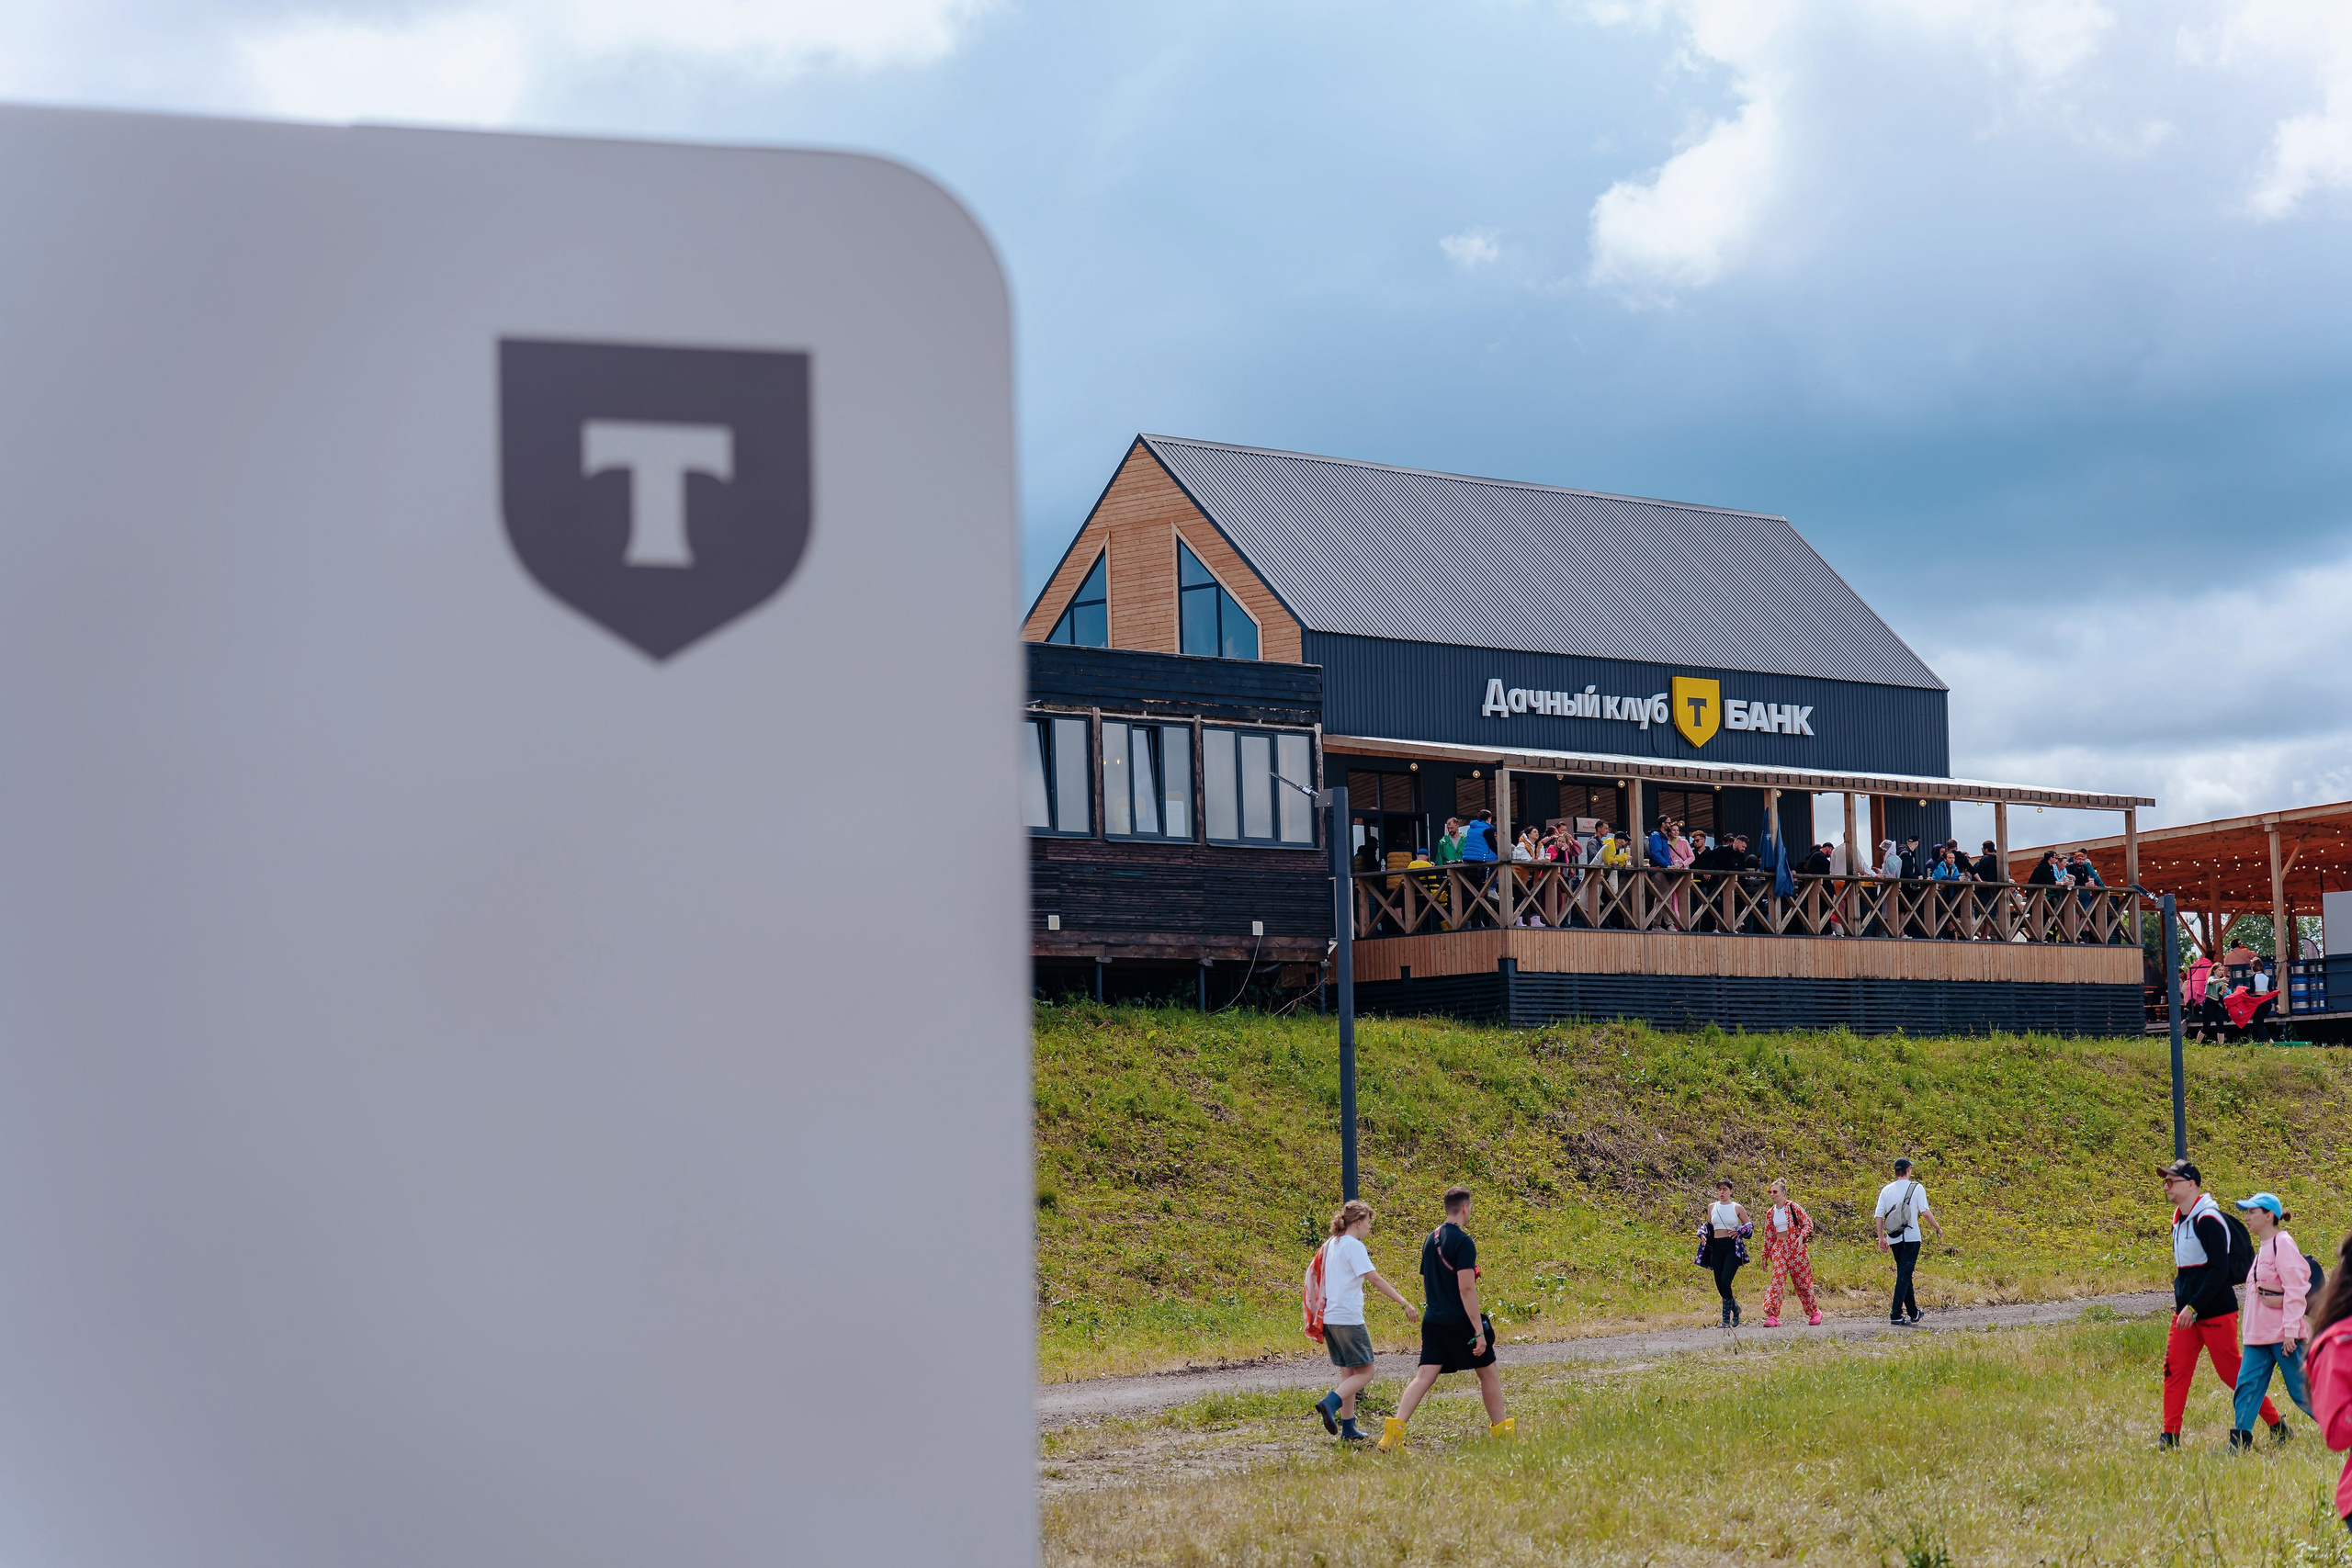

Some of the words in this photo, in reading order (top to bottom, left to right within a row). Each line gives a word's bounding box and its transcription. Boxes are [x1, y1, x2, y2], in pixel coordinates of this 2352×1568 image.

[582, 419, 734, 570] Т
[1482, 678, 1600, 718] Дачный
[1602, 693, 1669, 730] клуб
[1687, 697, 1707, 728] Т
[1724, 699, 1815, 736] БАНК
